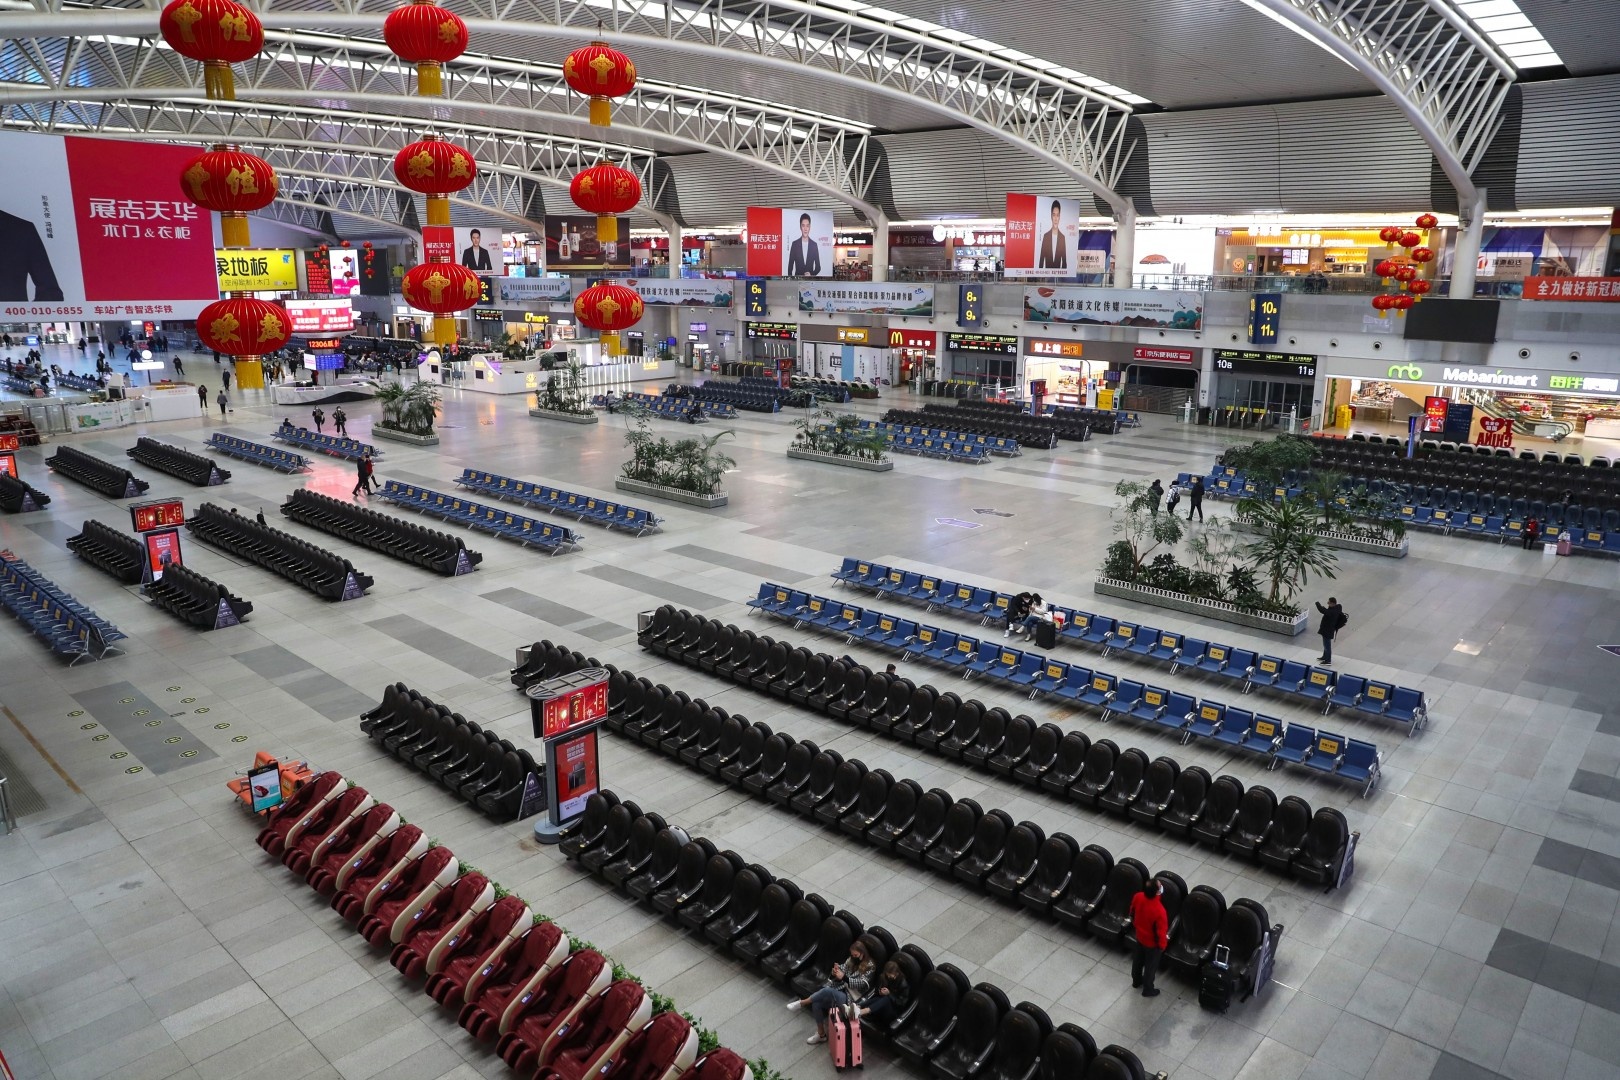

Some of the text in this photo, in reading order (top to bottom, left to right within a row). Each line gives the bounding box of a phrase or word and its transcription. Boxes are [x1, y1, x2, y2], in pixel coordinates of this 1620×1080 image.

[89, 198, 199, 222] 展志天华
[751, 284, 762, 294] 6B
[94, 304, 173, 315] 车站广告智选华铁
[751, 302, 762, 312] 7B
[1050, 299, 1119, 312] 沈阳铁道文化传媒
[5, 306, 84, 316] 400-010-6855
[1217, 359, 1233, 369] 10B
[1298, 365, 1315, 376] 11B
